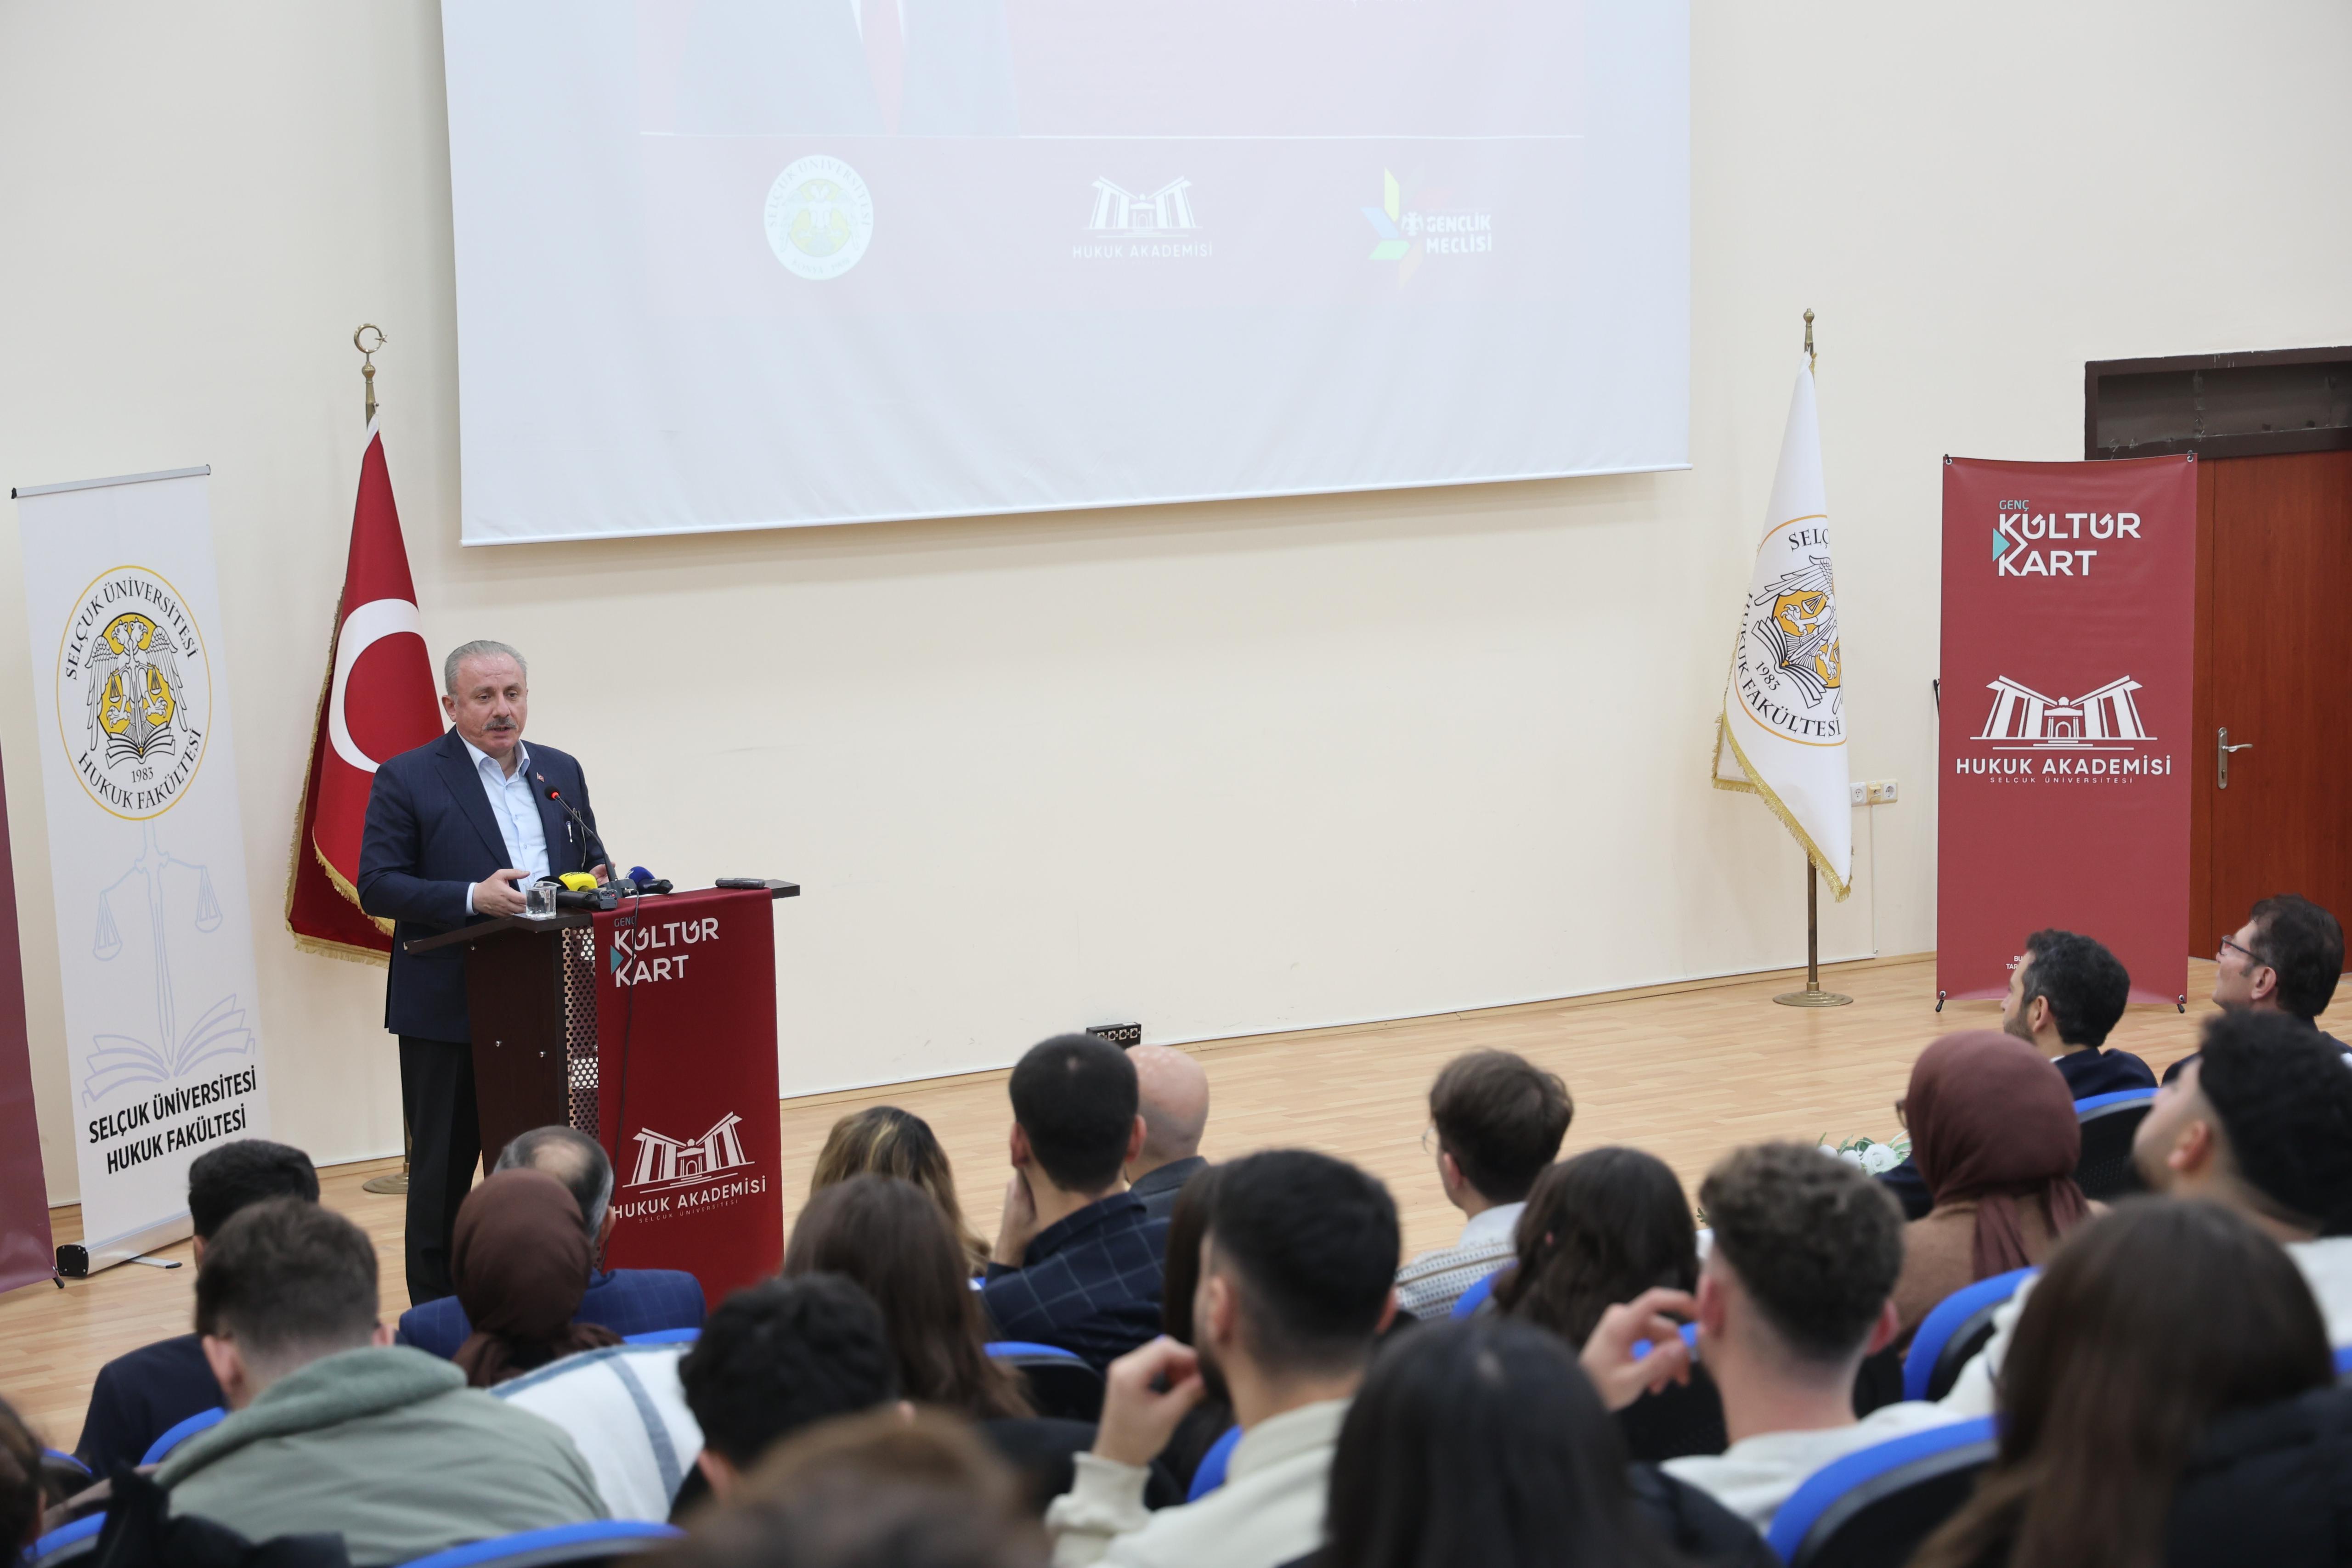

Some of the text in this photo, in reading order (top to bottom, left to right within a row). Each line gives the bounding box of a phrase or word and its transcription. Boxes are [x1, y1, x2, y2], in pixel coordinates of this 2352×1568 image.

[1426, 212, 1492, 235] GENÇLİK
[1073, 241, 1213, 259] HUKUK AKADEMİSİ
[1426, 233, 1492, 254] MECLİSİ
[1999, 500, 2030, 512] GENÇ
[1998, 550, 2097, 576] KART
[66, 576, 199, 681] SELÇUK ÜNİVERSİTESİ
[1754, 660, 1781, 691] 1983
[1742, 677, 1842, 738] FAKÜLTESİ
[78, 726, 202, 810] HUKUK FAKÜLTESİ
[131, 767, 153, 783] 1983
[1956, 755, 2171, 775] HUKUK AKADEMİSİ
[616, 954, 690, 988] KART
[89, 1065, 257, 1144] SELÇUK ÜNİVERSİTESİ
[107, 1103, 246, 1174] HUKUK FAKÜLTESİ
[613, 1175, 766, 1220] HUKUK AKADEMİSİ
